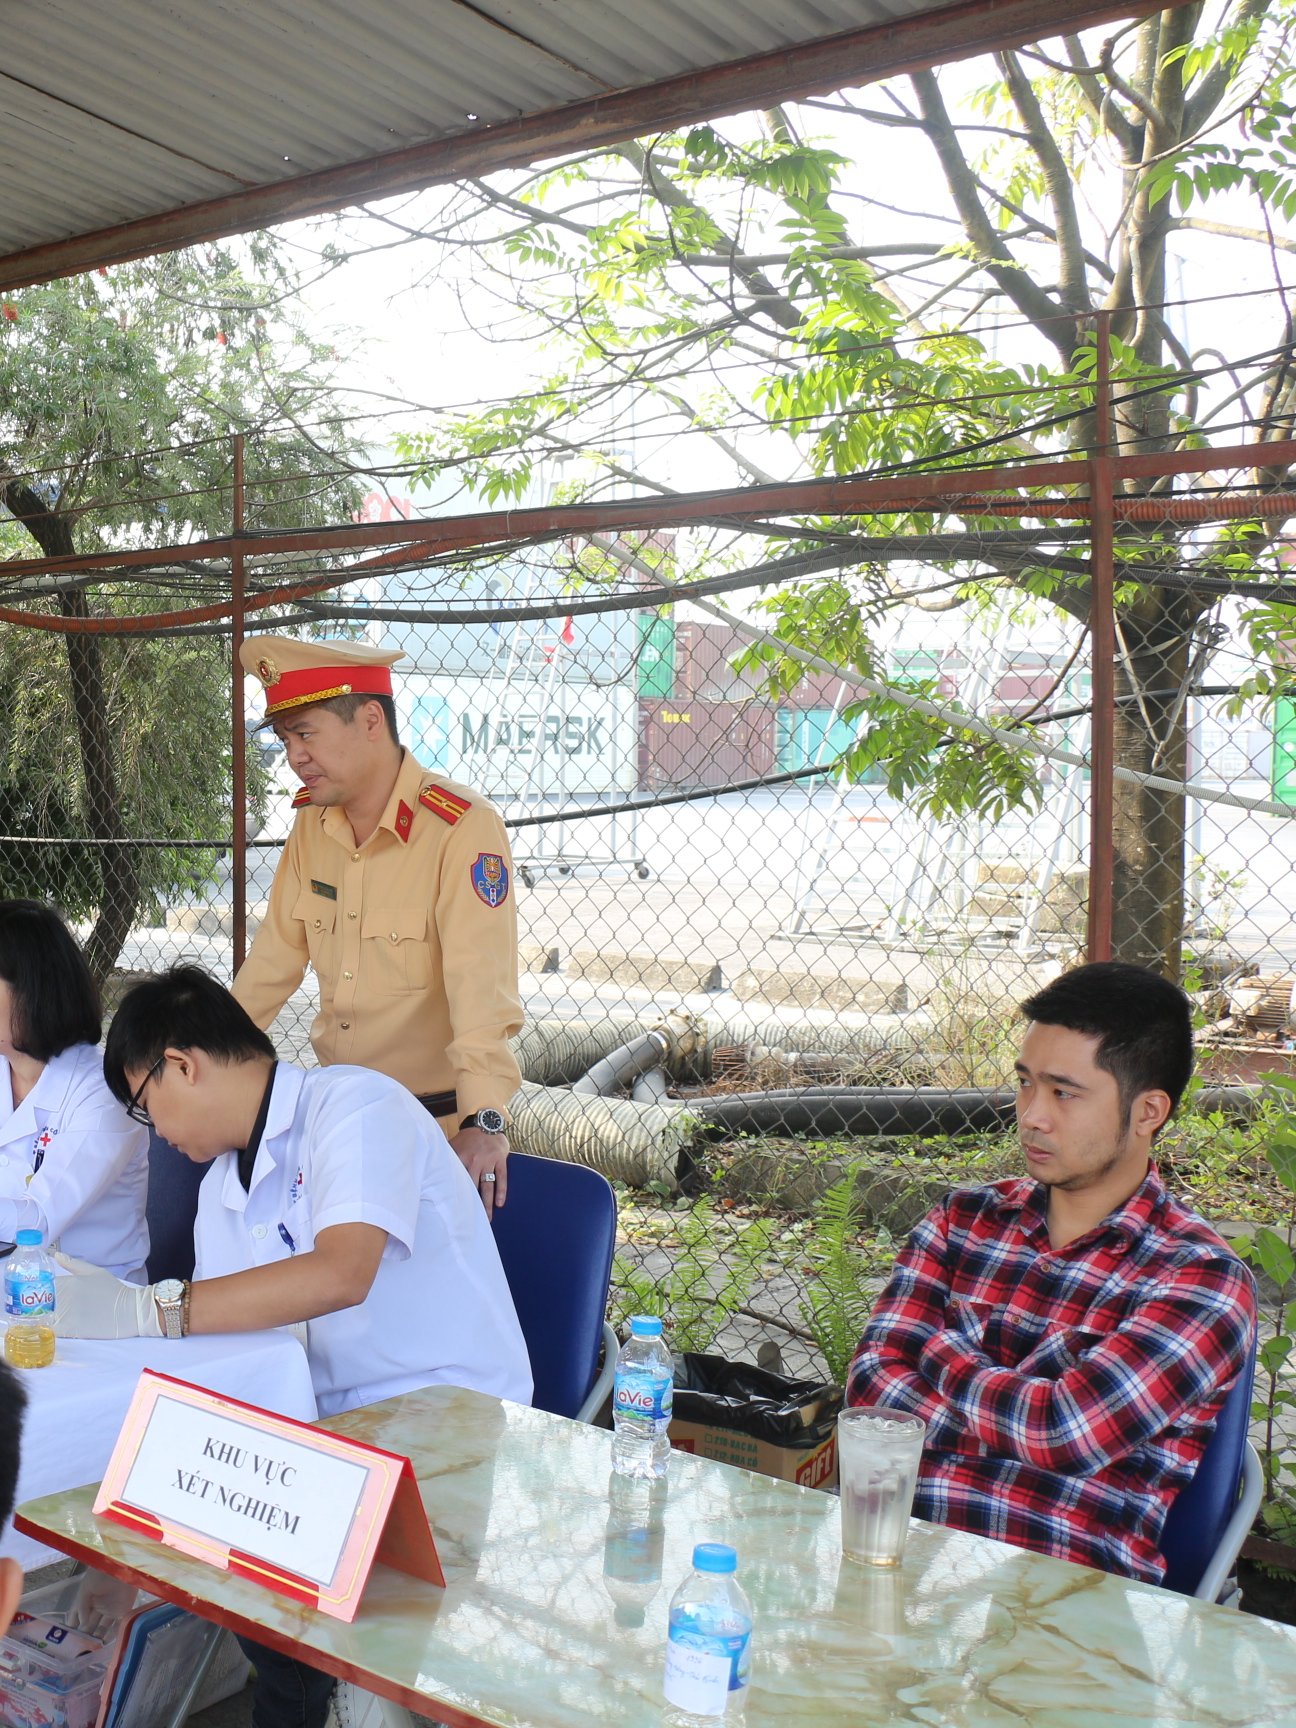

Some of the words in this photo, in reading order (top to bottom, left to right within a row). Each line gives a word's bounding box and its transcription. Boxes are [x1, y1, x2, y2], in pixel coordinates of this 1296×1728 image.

[462, 712, 606, 755] MAERSK
[21, 1290, 53, 1305] laVie
[202, 1437, 249, 1469] KHU
[253, 1454, 297, 1488] VỰC
[171, 1468, 214, 1501] XÉT
[214, 1485, 302, 1536] NGHIỆM
